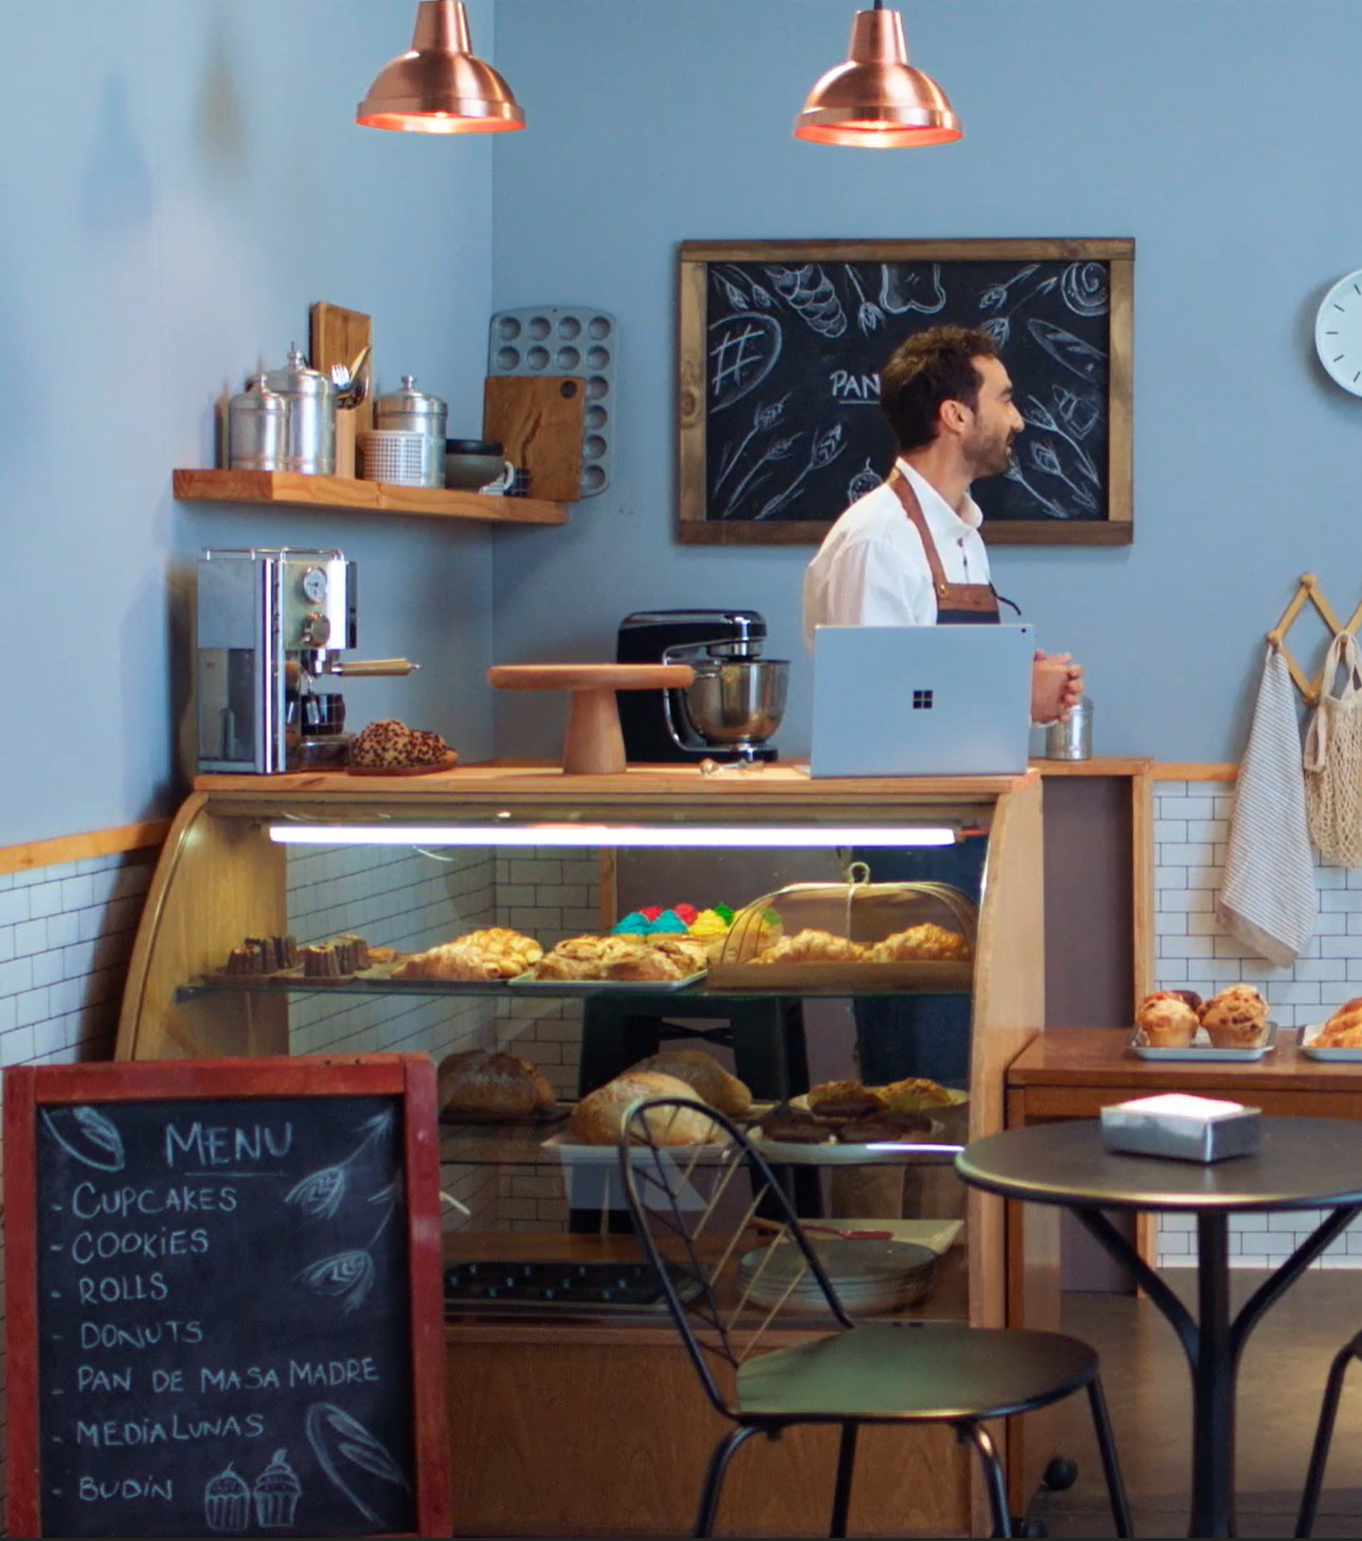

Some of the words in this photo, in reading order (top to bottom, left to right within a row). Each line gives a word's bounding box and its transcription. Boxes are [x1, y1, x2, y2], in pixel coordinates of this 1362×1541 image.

[165, 1122, 292, 1168] MENU
[72, 1182, 237, 1219] CUPCAKES
[79, 1272, 169, 1305] ROLLS
[81, 1320, 204, 1350] DONUTS
[78, 1365, 132, 1393] PAN
[152, 1369, 184, 1393] DE
[201, 1367, 280, 1394] MASA
[290, 1358, 380, 1388] MADRE
